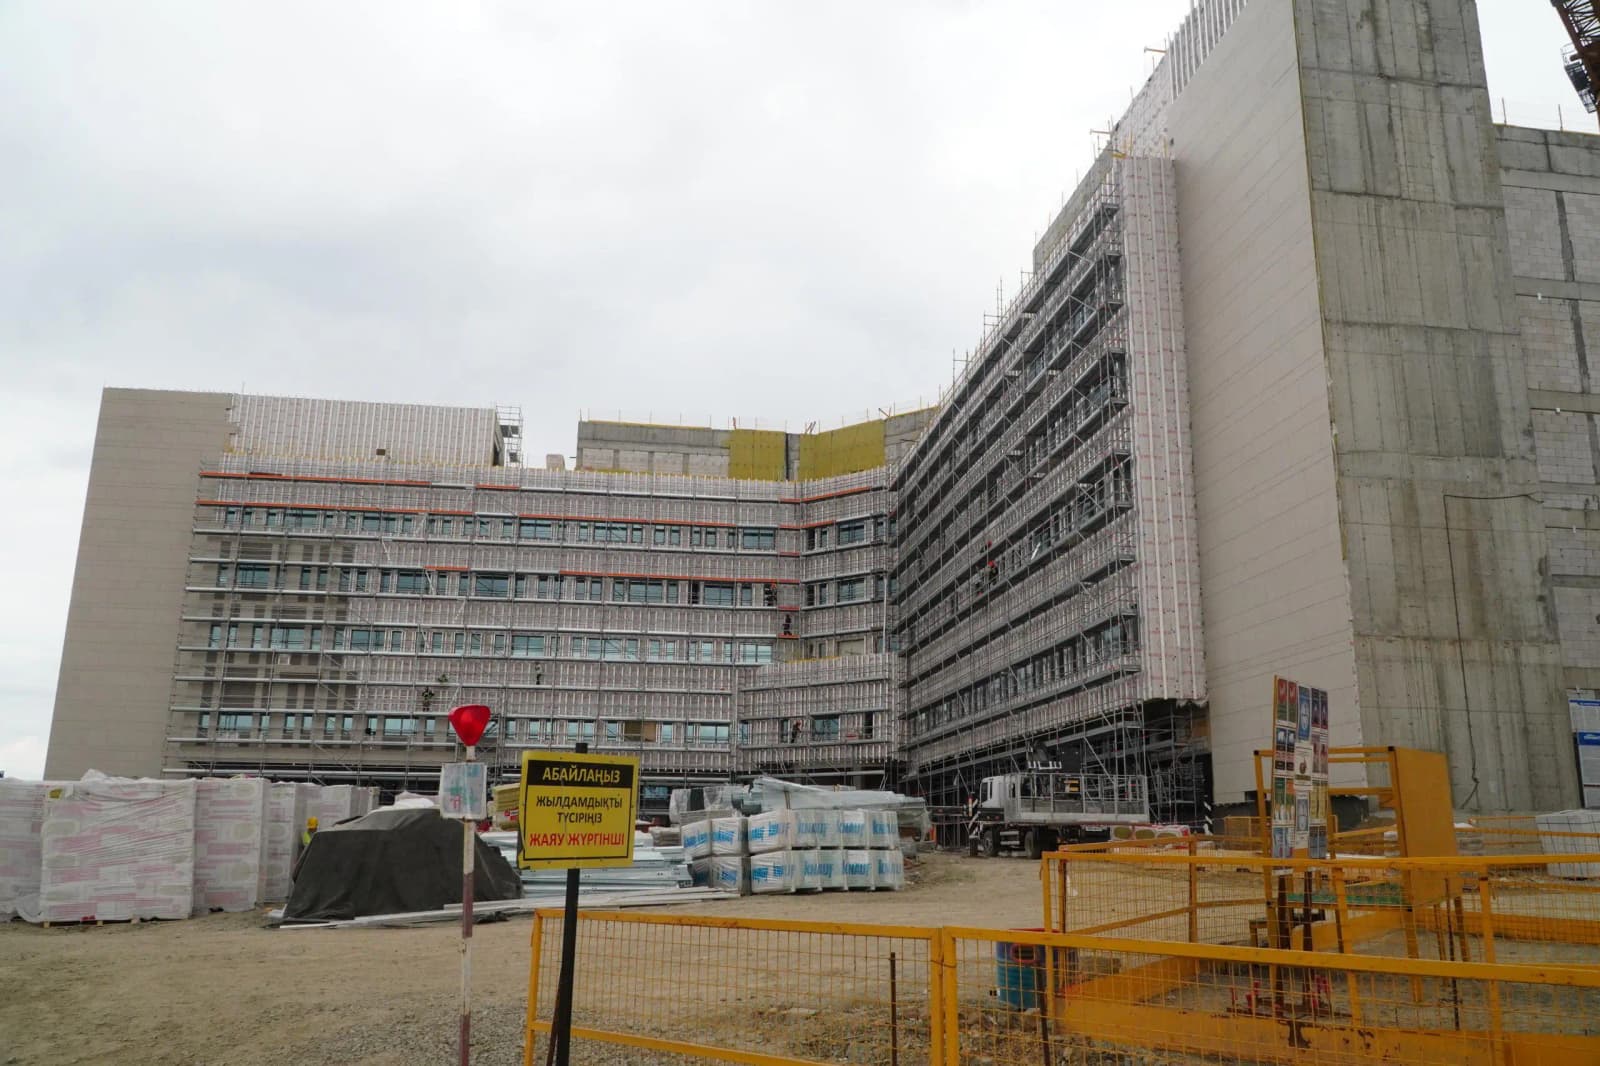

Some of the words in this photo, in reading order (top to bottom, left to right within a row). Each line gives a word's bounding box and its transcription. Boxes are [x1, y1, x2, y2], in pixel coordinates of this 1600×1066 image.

[542, 764, 621, 785] АБАЙЛАҢЫЗ
[536, 795, 623, 811] ЖЫЛДАМДЫҚТЫ
[557, 812, 603, 826] ТҮСІРІҢІЗ
[529, 832, 565, 847] ЖАЯУ
[567, 832, 625, 846] ЖҮРГІНШІ
